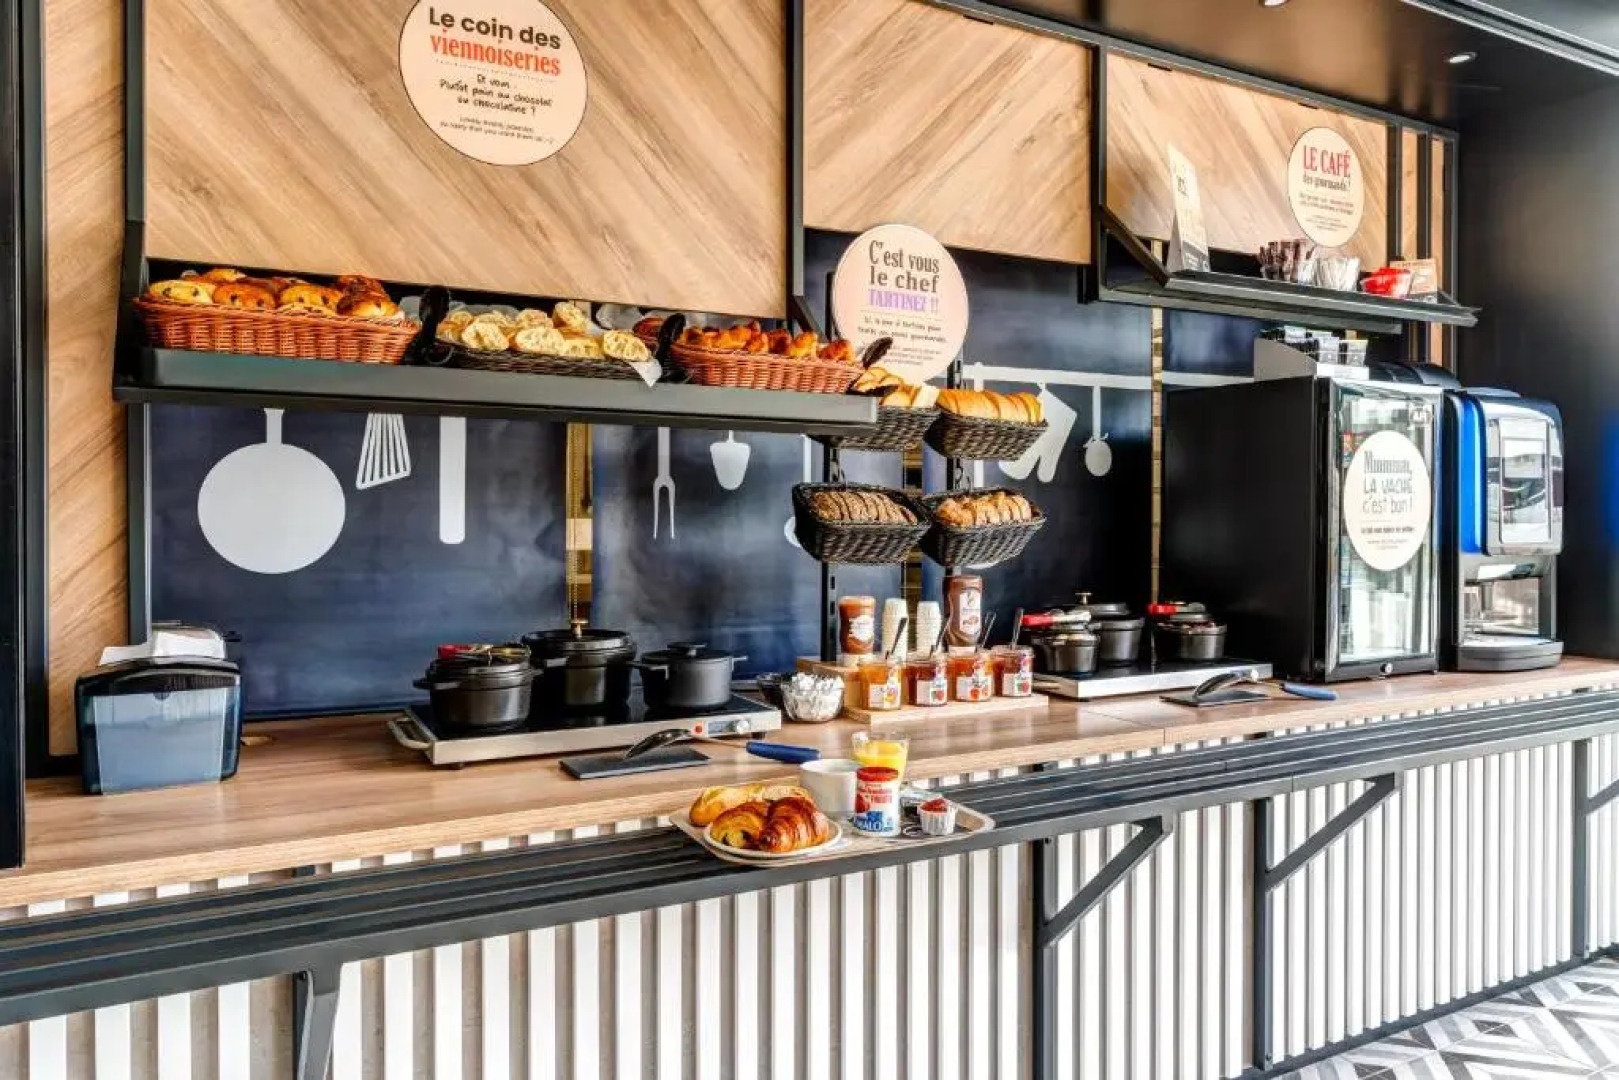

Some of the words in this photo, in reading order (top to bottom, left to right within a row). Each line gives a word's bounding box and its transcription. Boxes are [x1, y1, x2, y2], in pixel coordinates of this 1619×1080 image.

[429, 7, 455, 28] Le
[461, 17, 513, 40] coin
[519, 27, 561, 50] des
[430, 29, 561, 76] viennoiseries
[472, 87, 493, 97] pain
[1303, 145, 1318, 172] LE
[1321, 149, 1351, 177] CAFÉ
[869, 240, 904, 268] C'est
[908, 254, 940, 273] vous
[870, 265, 888, 286] le
[895, 270, 939, 293] chef
[869, 289, 928, 312] TARTINEZ
[1364, 477, 1377, 494] LA
